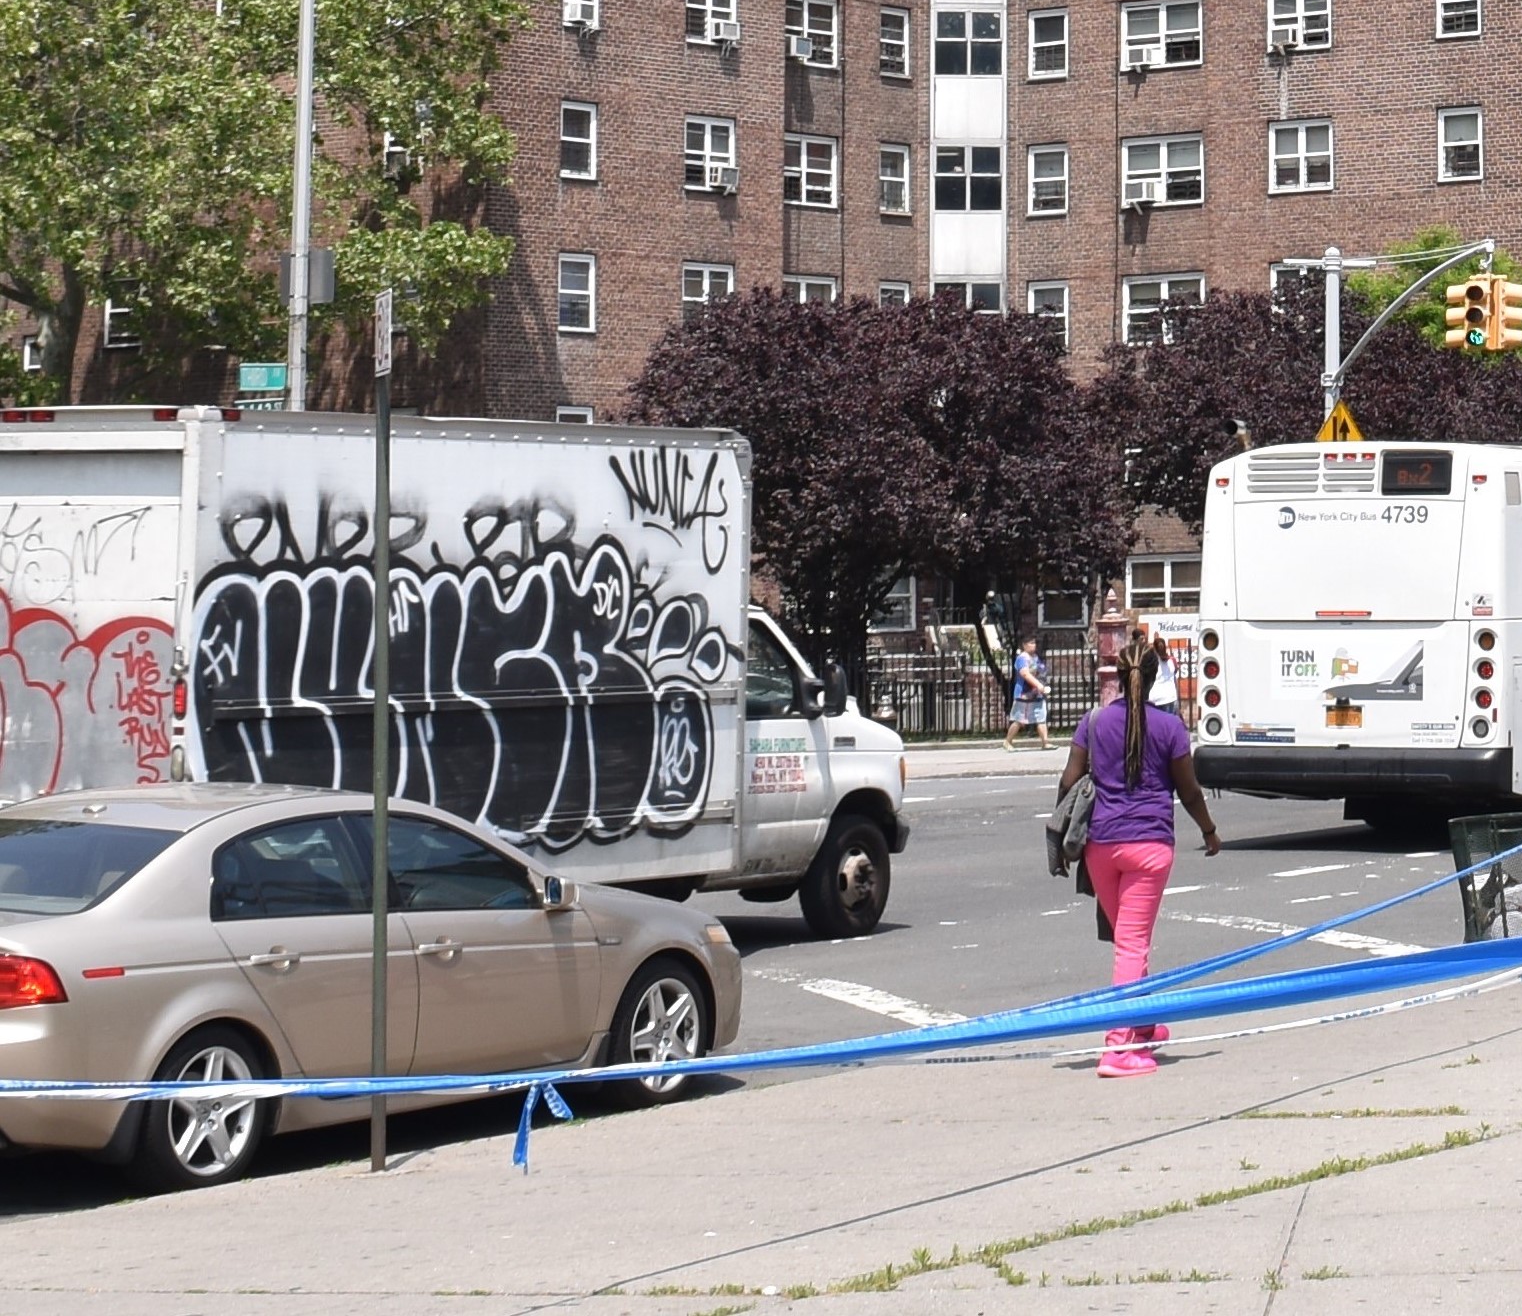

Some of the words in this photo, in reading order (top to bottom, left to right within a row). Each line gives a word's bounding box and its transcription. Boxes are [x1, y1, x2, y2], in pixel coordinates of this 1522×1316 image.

[1298, 513, 1317, 522] New
[1319, 512, 1338, 522] York
[1340, 511, 1358, 523] City
[1360, 512, 1377, 522] Bus
[1381, 505, 1429, 524] 4739
[1157, 621, 1194, 633] Welcome
[1280, 650, 1315, 663] TURN
[1281, 663, 1292, 677] IT
[1294, 663, 1320, 677] OFF.
